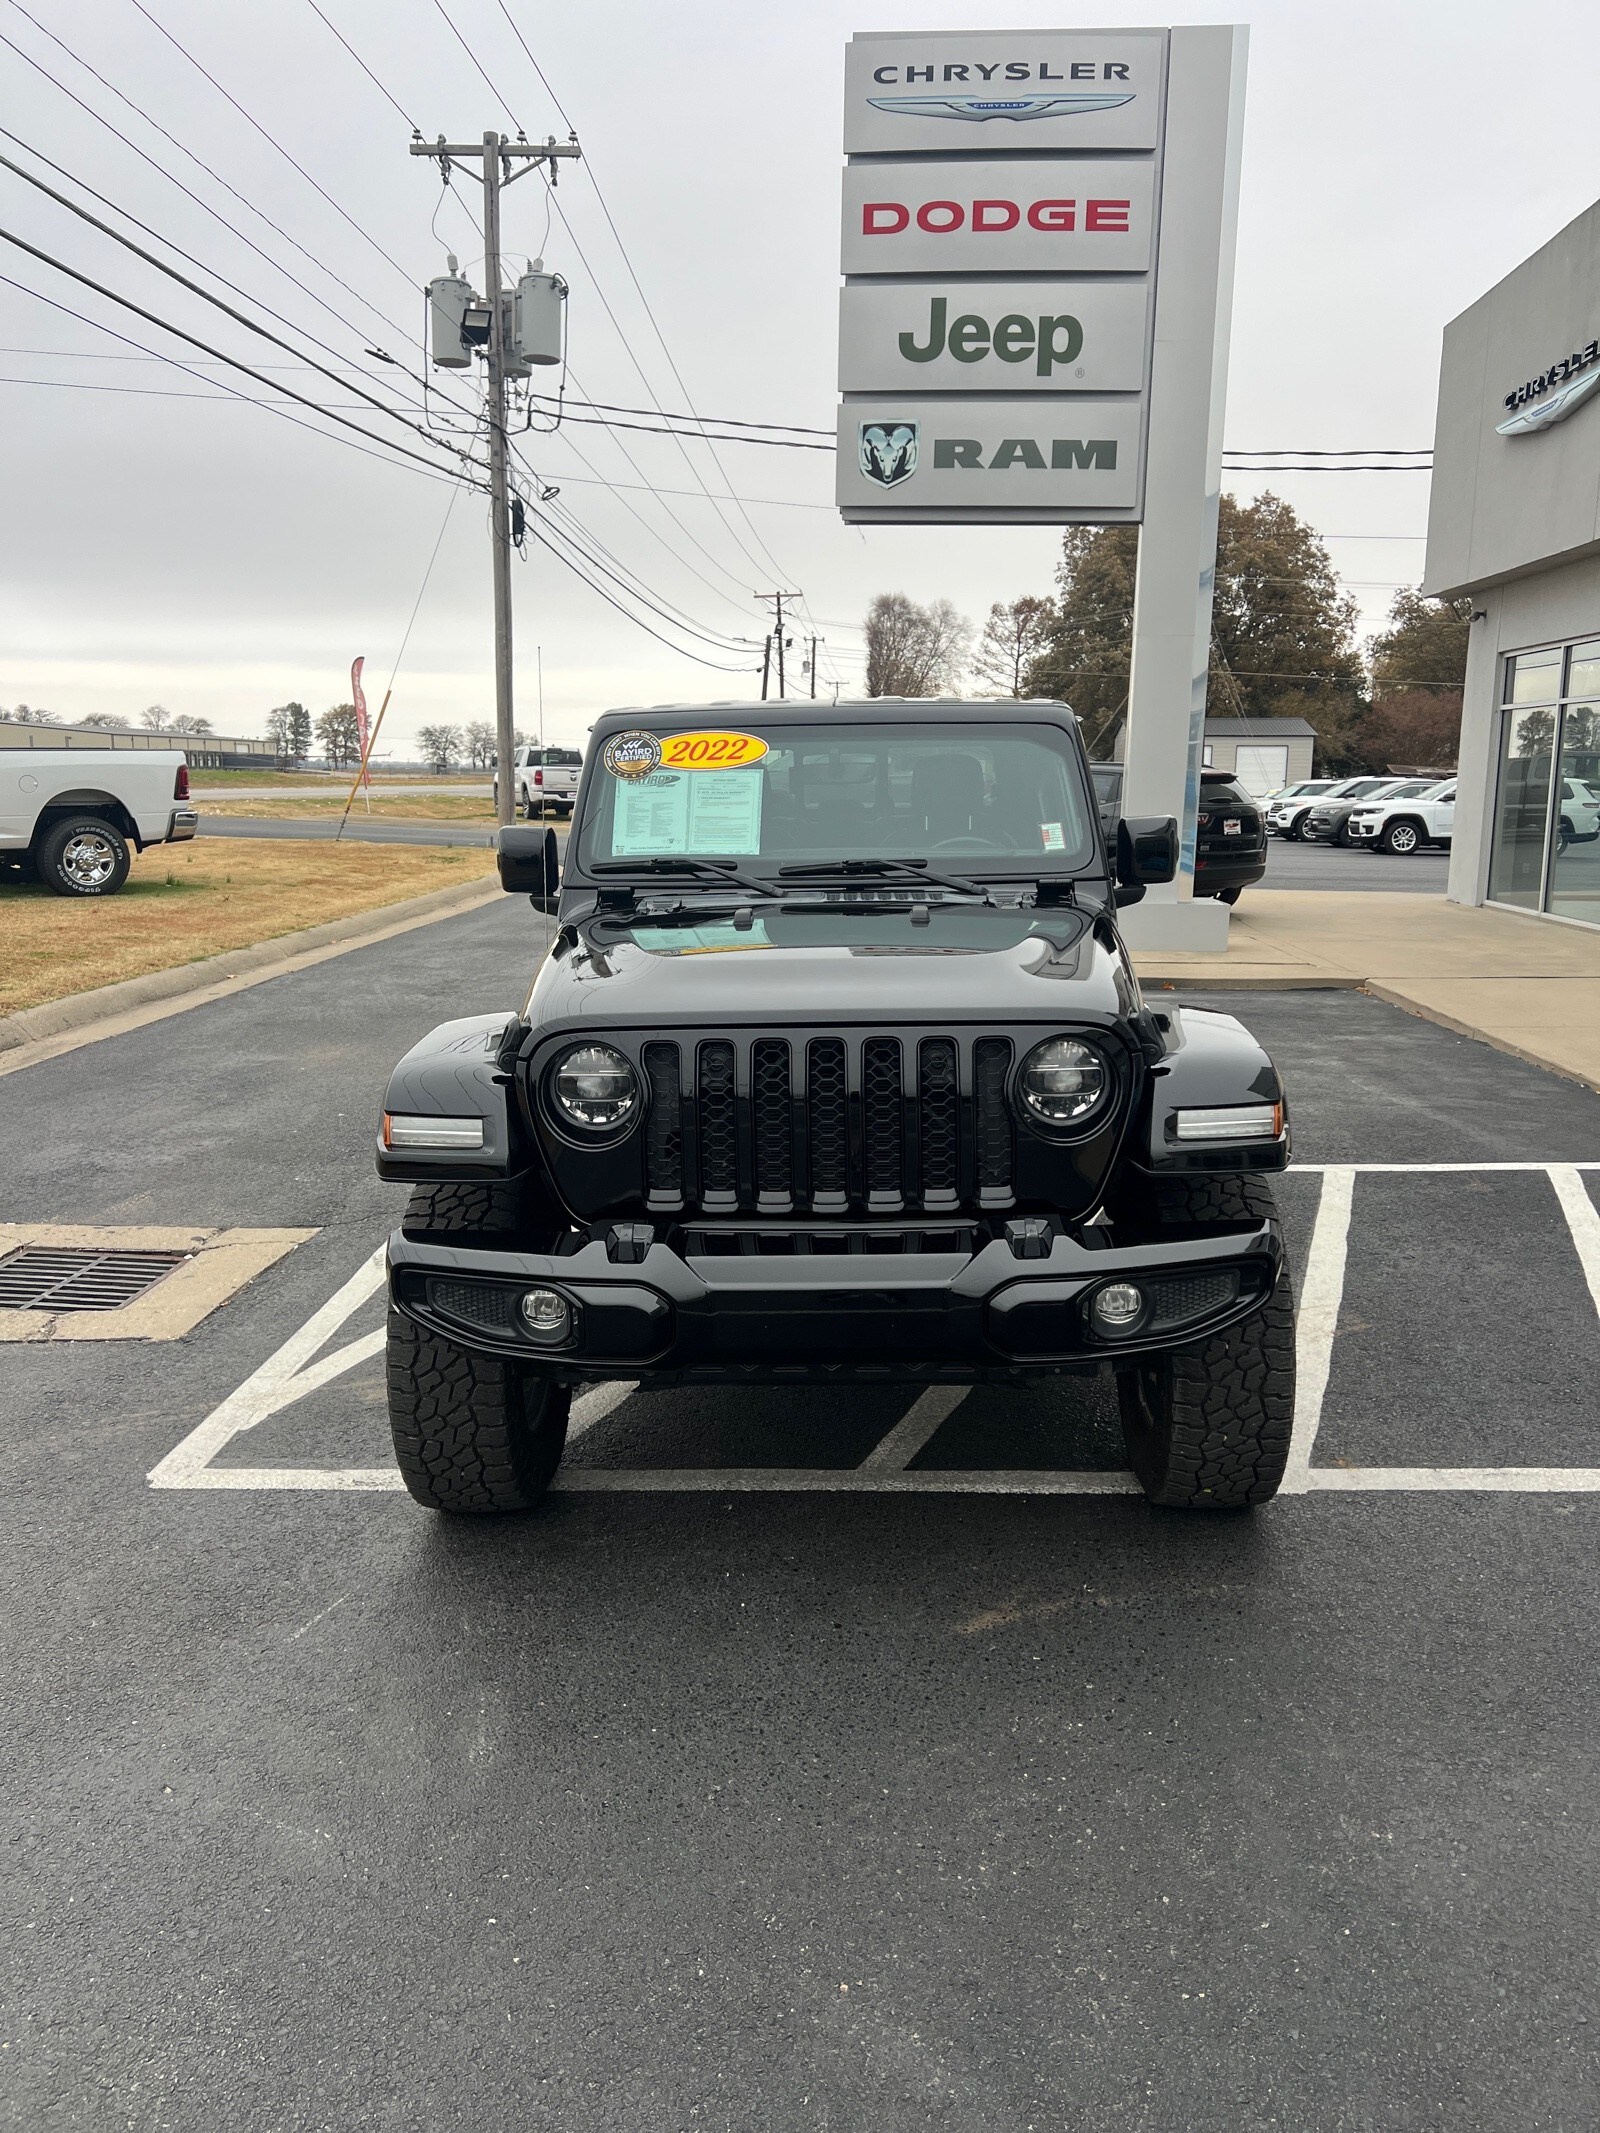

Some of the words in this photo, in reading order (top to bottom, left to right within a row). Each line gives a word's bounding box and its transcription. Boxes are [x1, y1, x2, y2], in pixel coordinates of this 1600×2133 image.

[873, 62, 1130, 85] CHRYSLER
[863, 200, 1130, 235] DODGE
[899, 298, 1084, 377] Jeep
[933, 439, 1118, 470] RAM
[615, 747, 652, 757] BAYIRD
[615, 754, 652, 762] CERTIFIED
[667, 739, 749, 762] 2022
